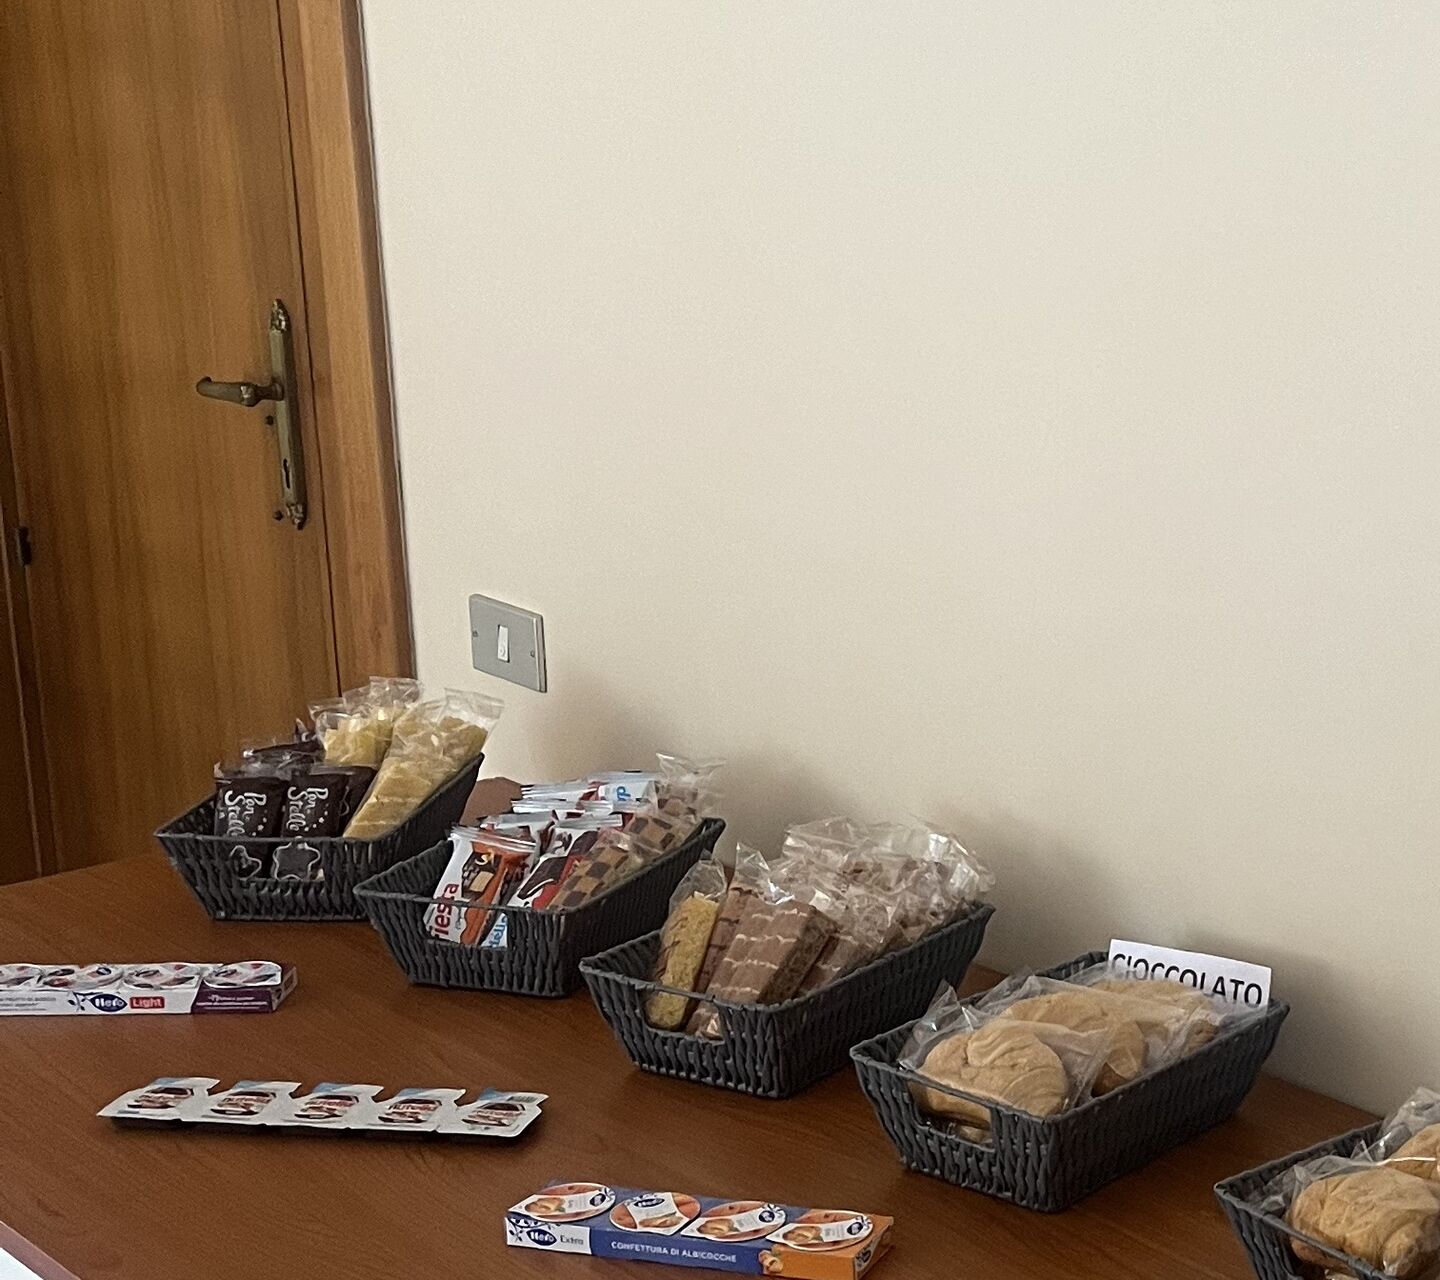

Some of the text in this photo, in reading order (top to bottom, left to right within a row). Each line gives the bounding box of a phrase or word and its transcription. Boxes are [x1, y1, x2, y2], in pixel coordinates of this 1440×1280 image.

[95, 993, 164, 1009] Hero Light
[529, 1230, 585, 1246] Hero Extra
[611, 1241, 669, 1255] CONFETTURA
[670, 1248, 680, 1257] DI
